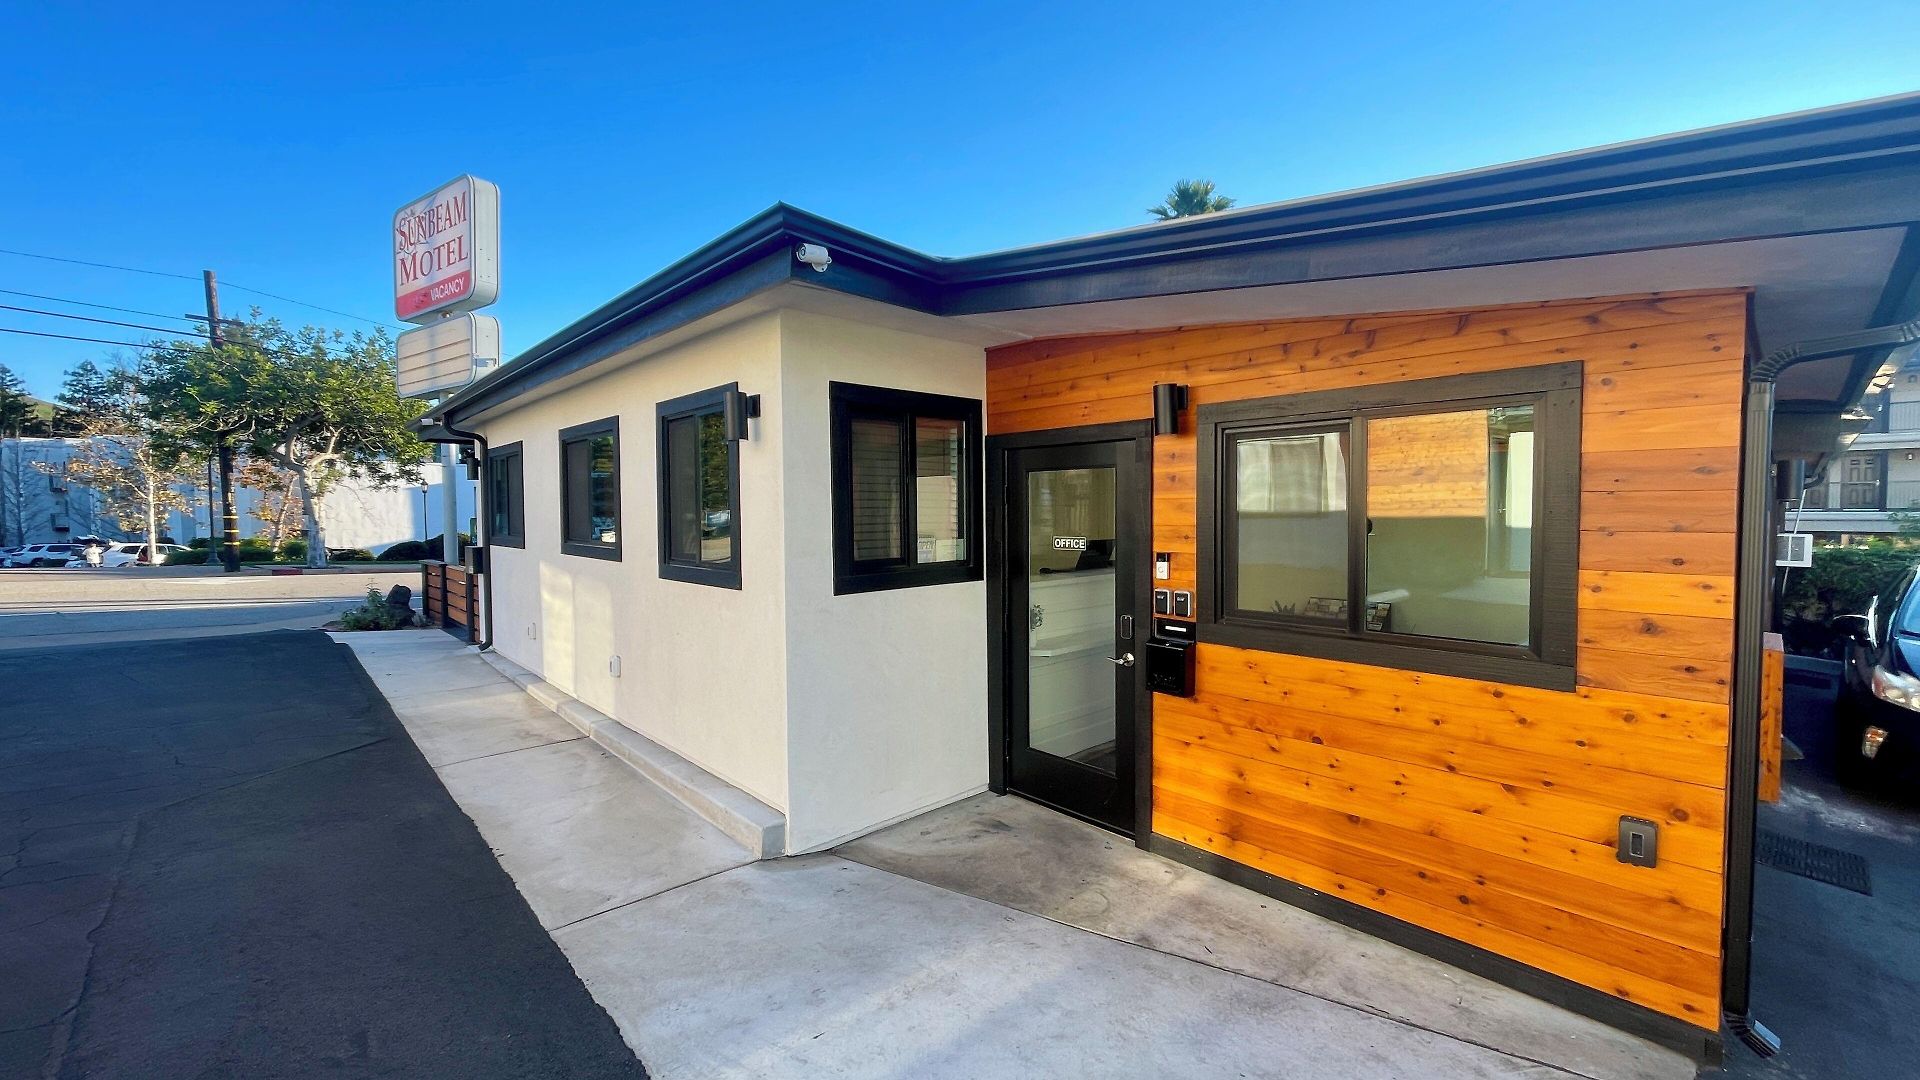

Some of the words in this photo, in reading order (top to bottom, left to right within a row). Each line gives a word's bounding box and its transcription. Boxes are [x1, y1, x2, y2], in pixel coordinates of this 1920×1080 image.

[397, 191, 467, 250] SUNBEAM
[400, 235, 469, 286] MOTEL
[430, 277, 465, 302] VACANCY
[1054, 538, 1085, 549] OFFICE
